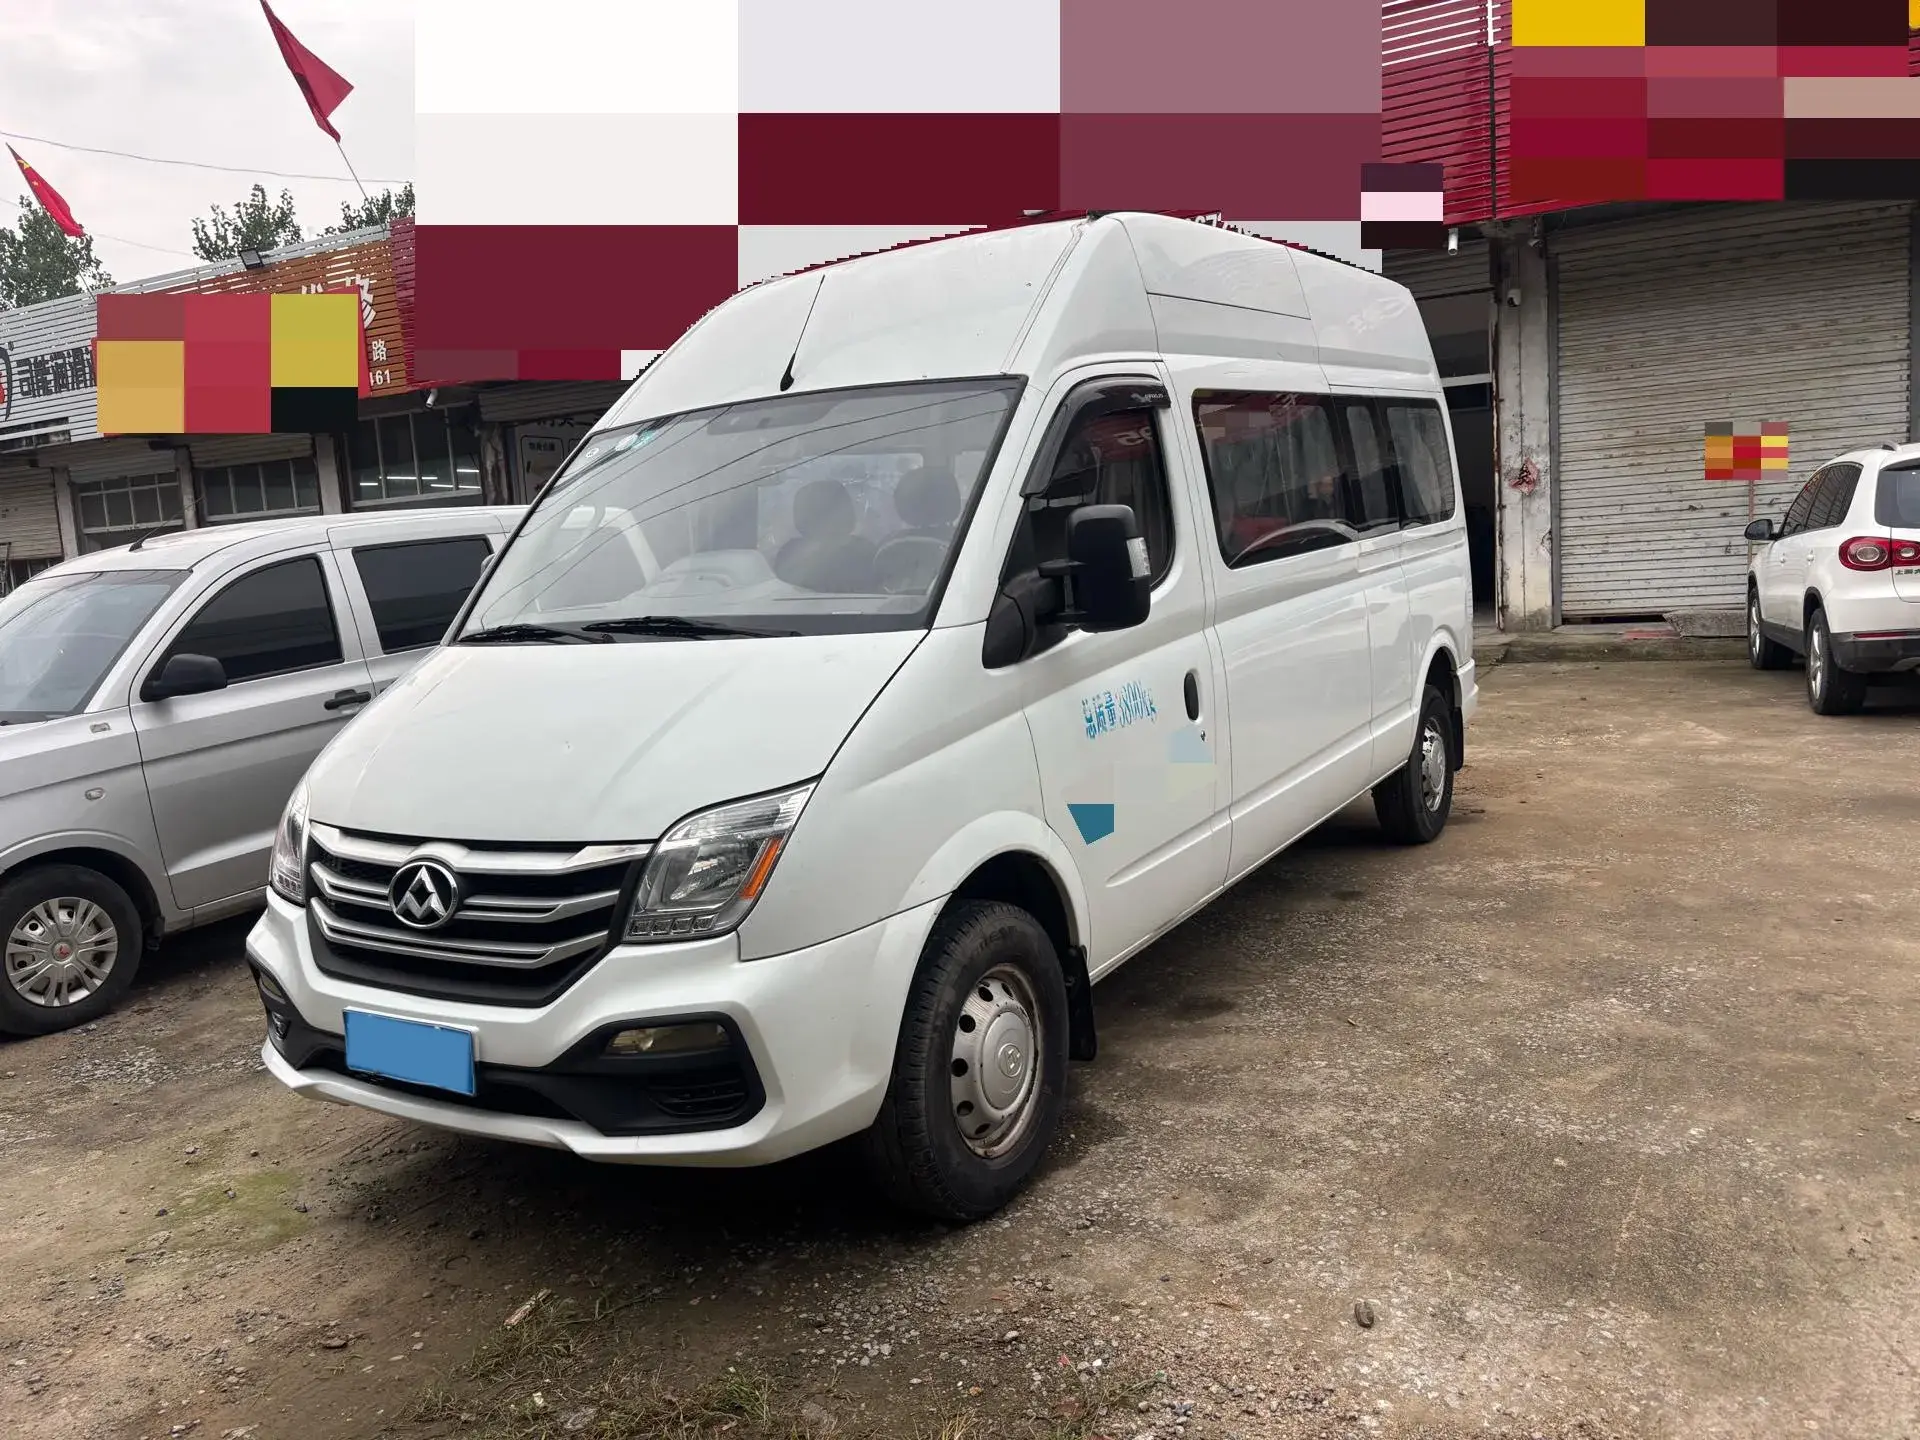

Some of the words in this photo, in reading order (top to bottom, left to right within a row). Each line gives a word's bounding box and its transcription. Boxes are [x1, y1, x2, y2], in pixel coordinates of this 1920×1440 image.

[371, 339, 387, 361] 路
[17, 347, 97, 397] 司能润滑
